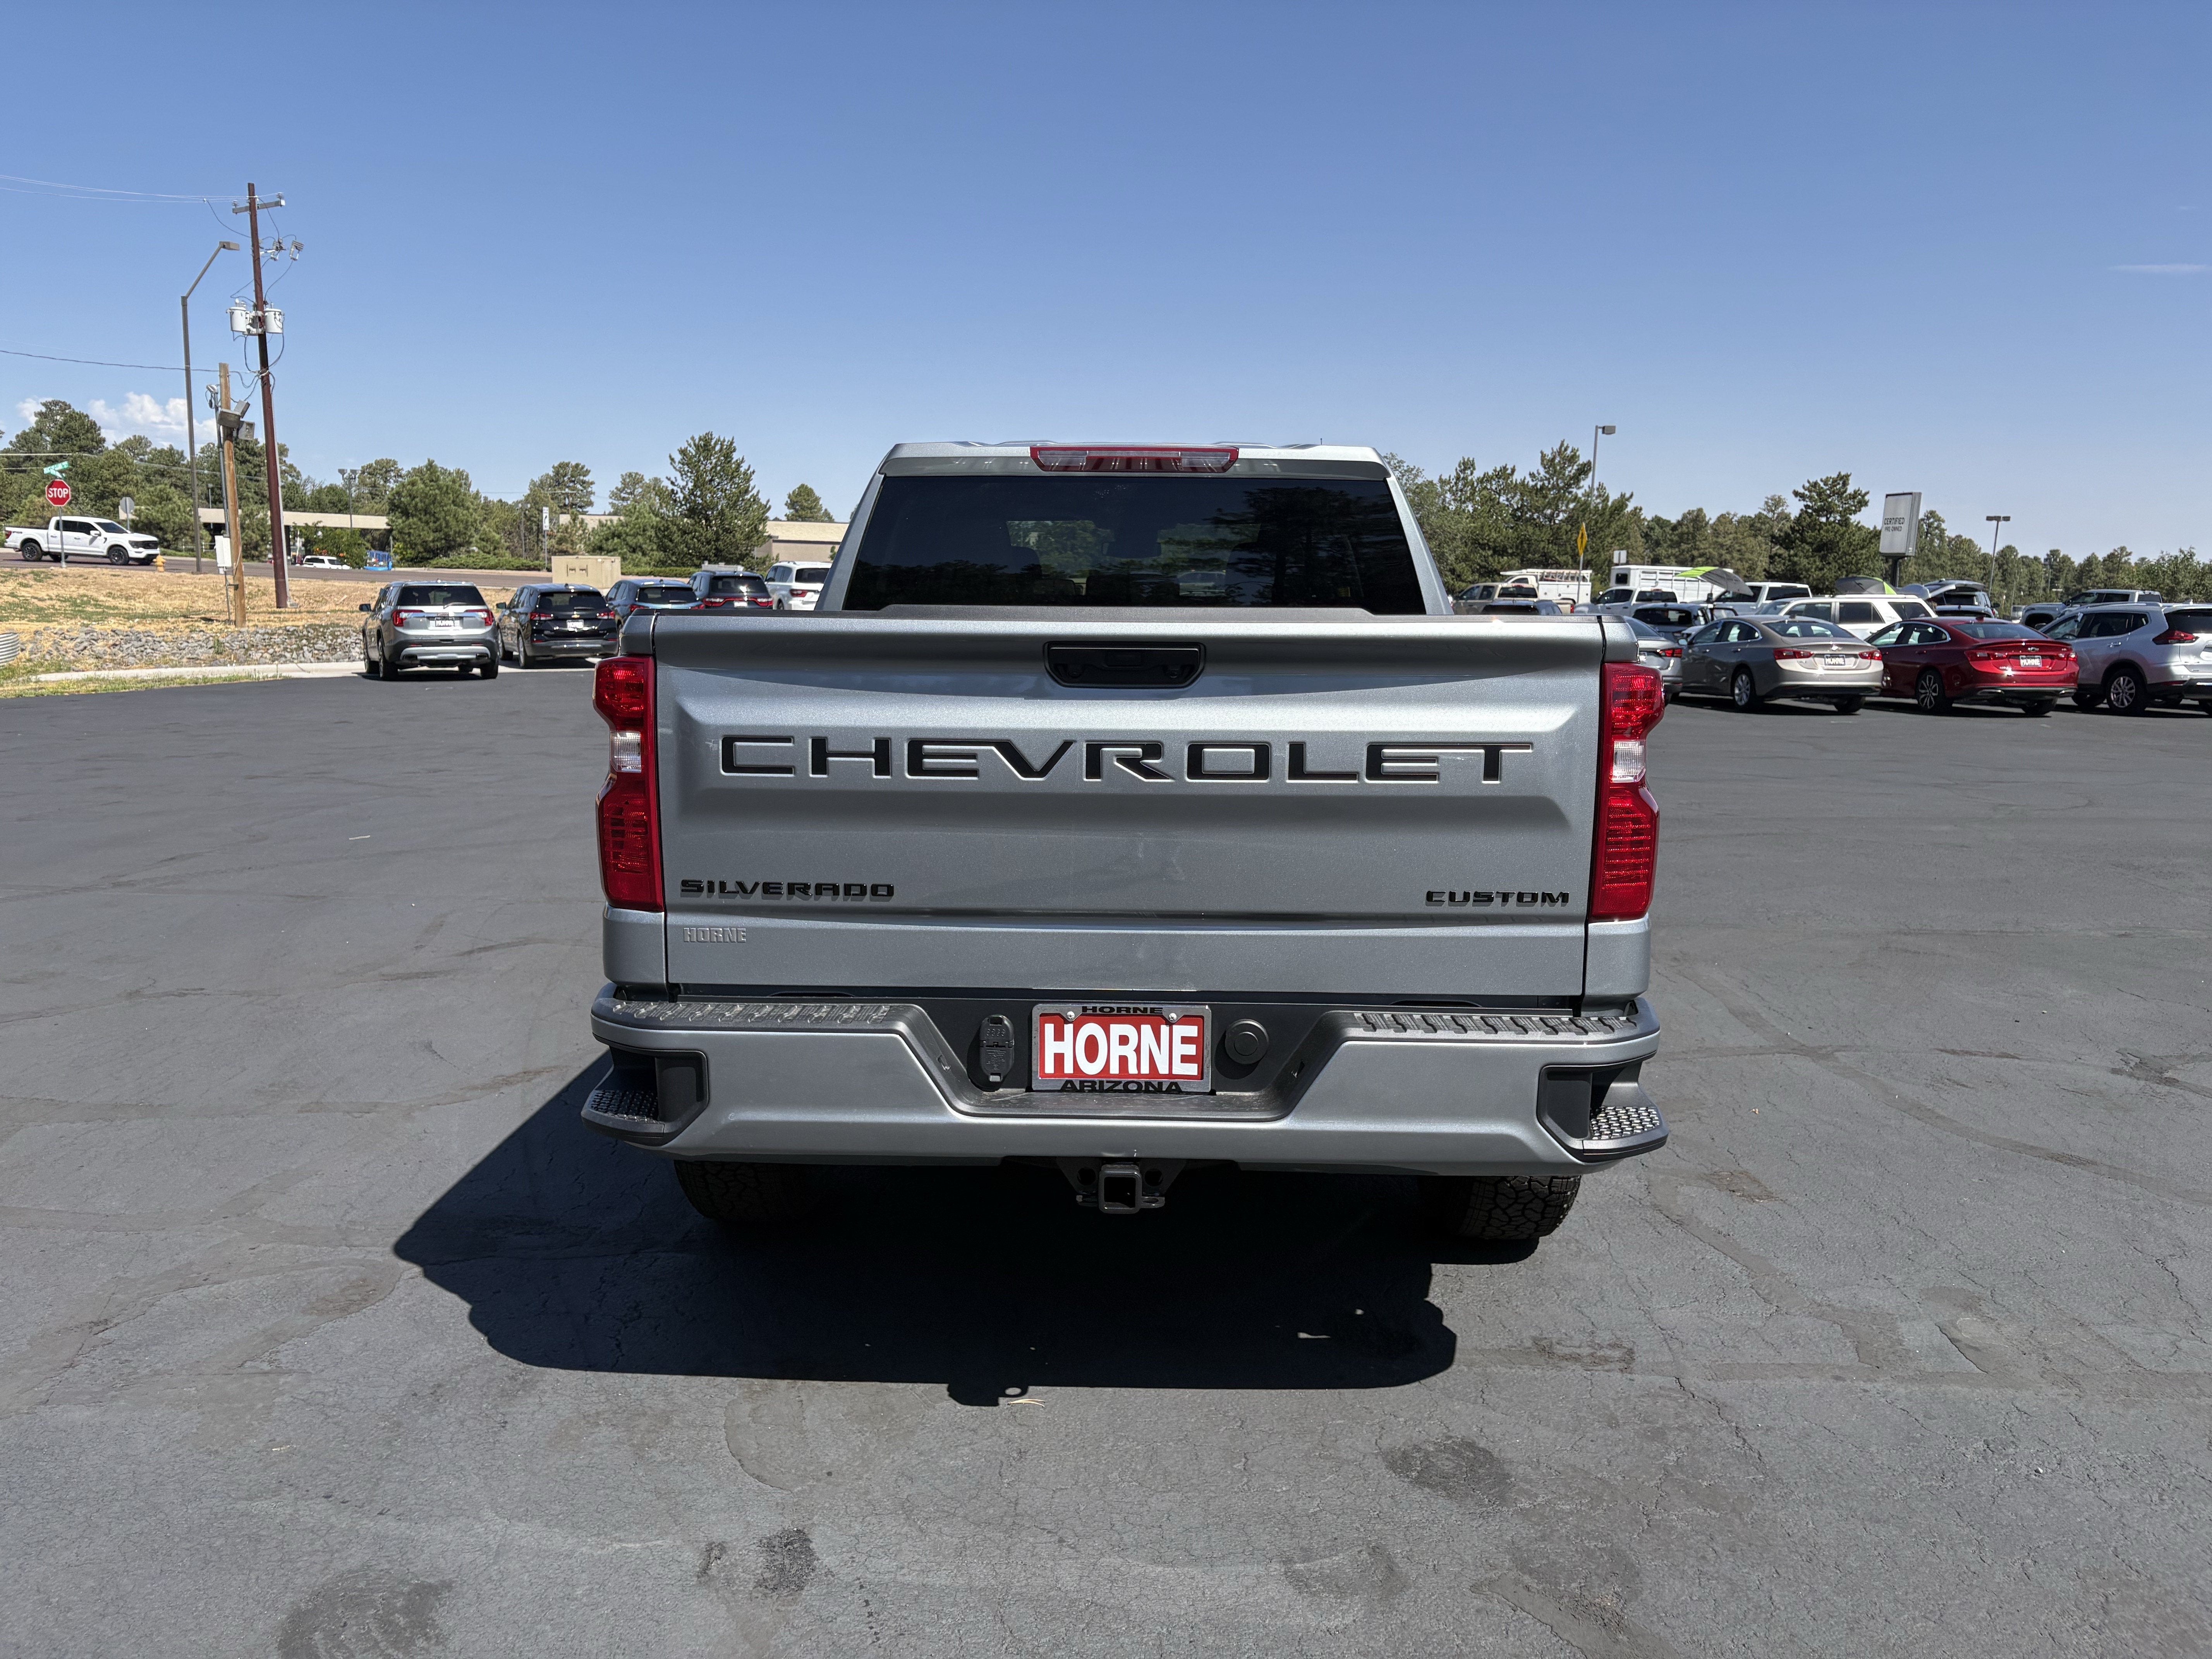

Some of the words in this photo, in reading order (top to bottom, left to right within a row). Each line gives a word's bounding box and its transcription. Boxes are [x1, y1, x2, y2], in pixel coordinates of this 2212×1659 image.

[48, 488, 68, 498] STOP
[721, 735, 1532, 783] CHEVROLET
[681, 879, 894, 896] SILVERADO
[1426, 891, 1570, 903] CUSTOM
[683, 928, 746, 942] HORNE
[1082, 1006, 1163, 1014] HORNE
[1044, 1022, 1198, 1076] HORNE
[1060, 1080, 1183, 1093] ARIZONA
